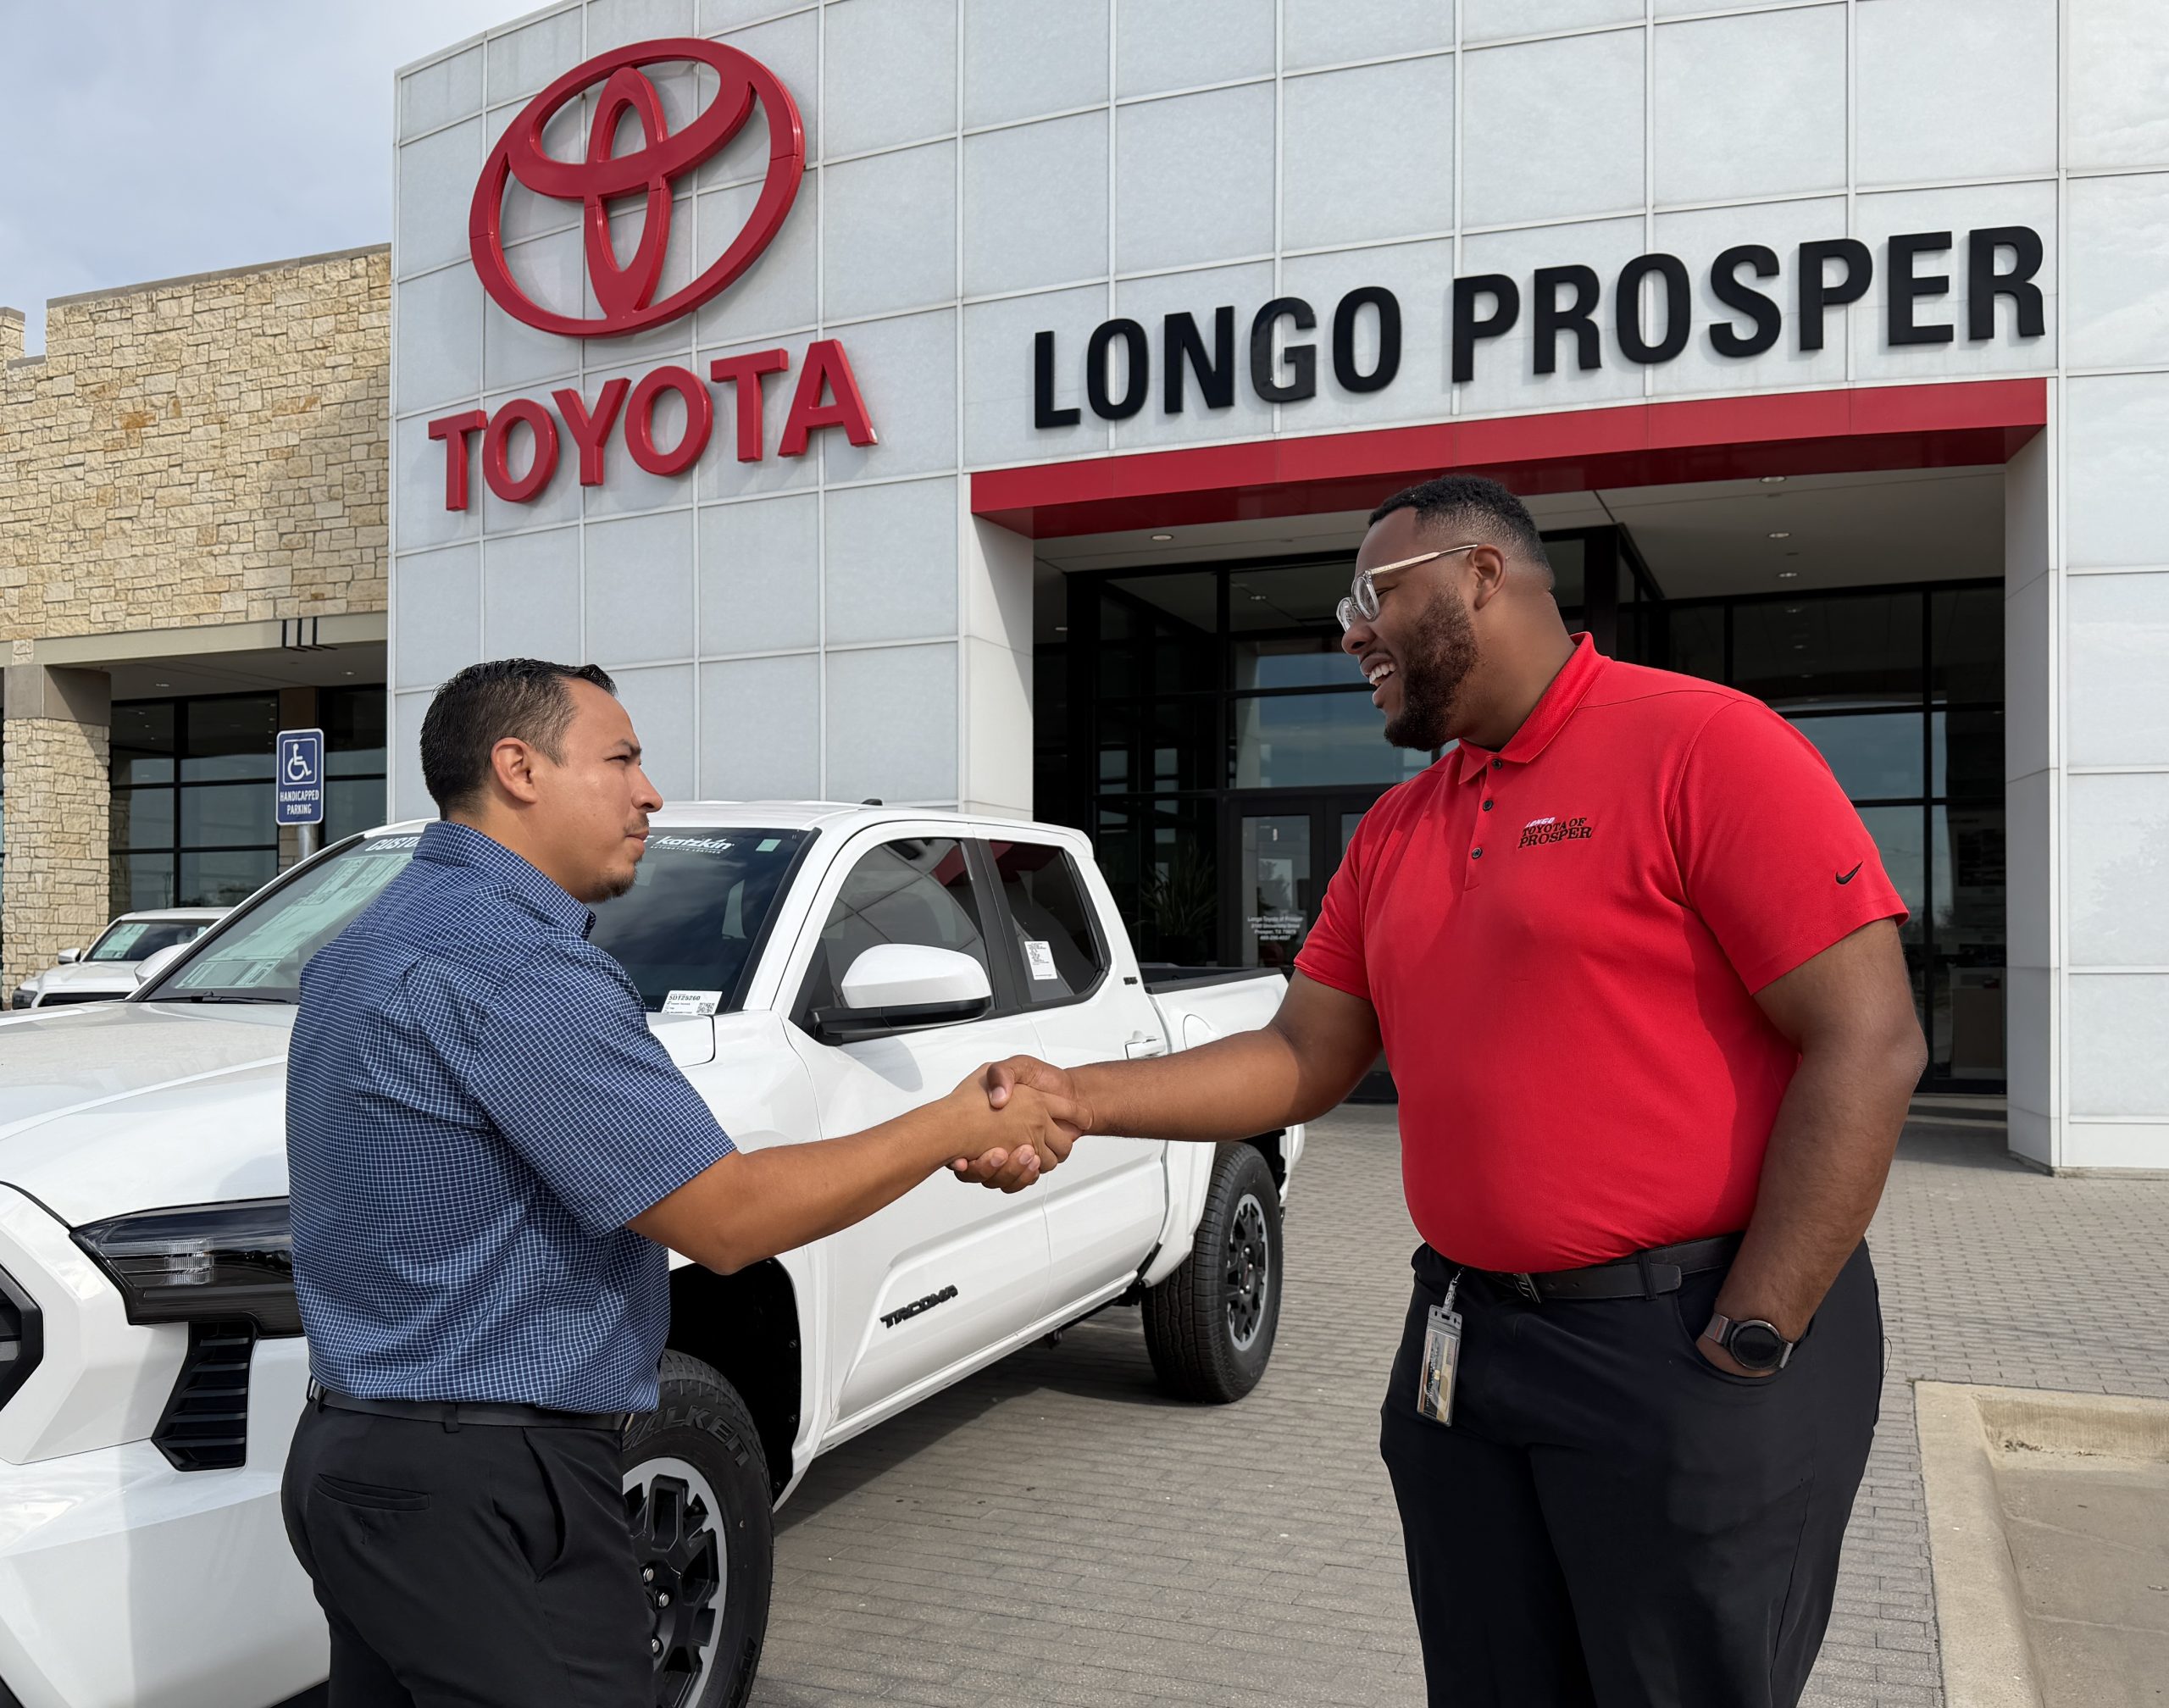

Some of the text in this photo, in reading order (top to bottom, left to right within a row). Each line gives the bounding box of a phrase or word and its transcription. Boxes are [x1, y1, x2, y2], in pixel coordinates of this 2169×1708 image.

[1035, 225, 2046, 430] LONGO PROSPER
[428, 339, 878, 512] TOYOTA
[280, 790, 319, 802] HANDICAPPED
[286, 804, 312, 815] PARKING
[1522, 818, 1587, 837] TOYOTA OF
[1525, 817, 1556, 829] LONGO
[364, 836, 422, 852] CUSTO
[1517, 827, 1593, 849] PROSPER
[880, 1284, 958, 1328] TACOMA
